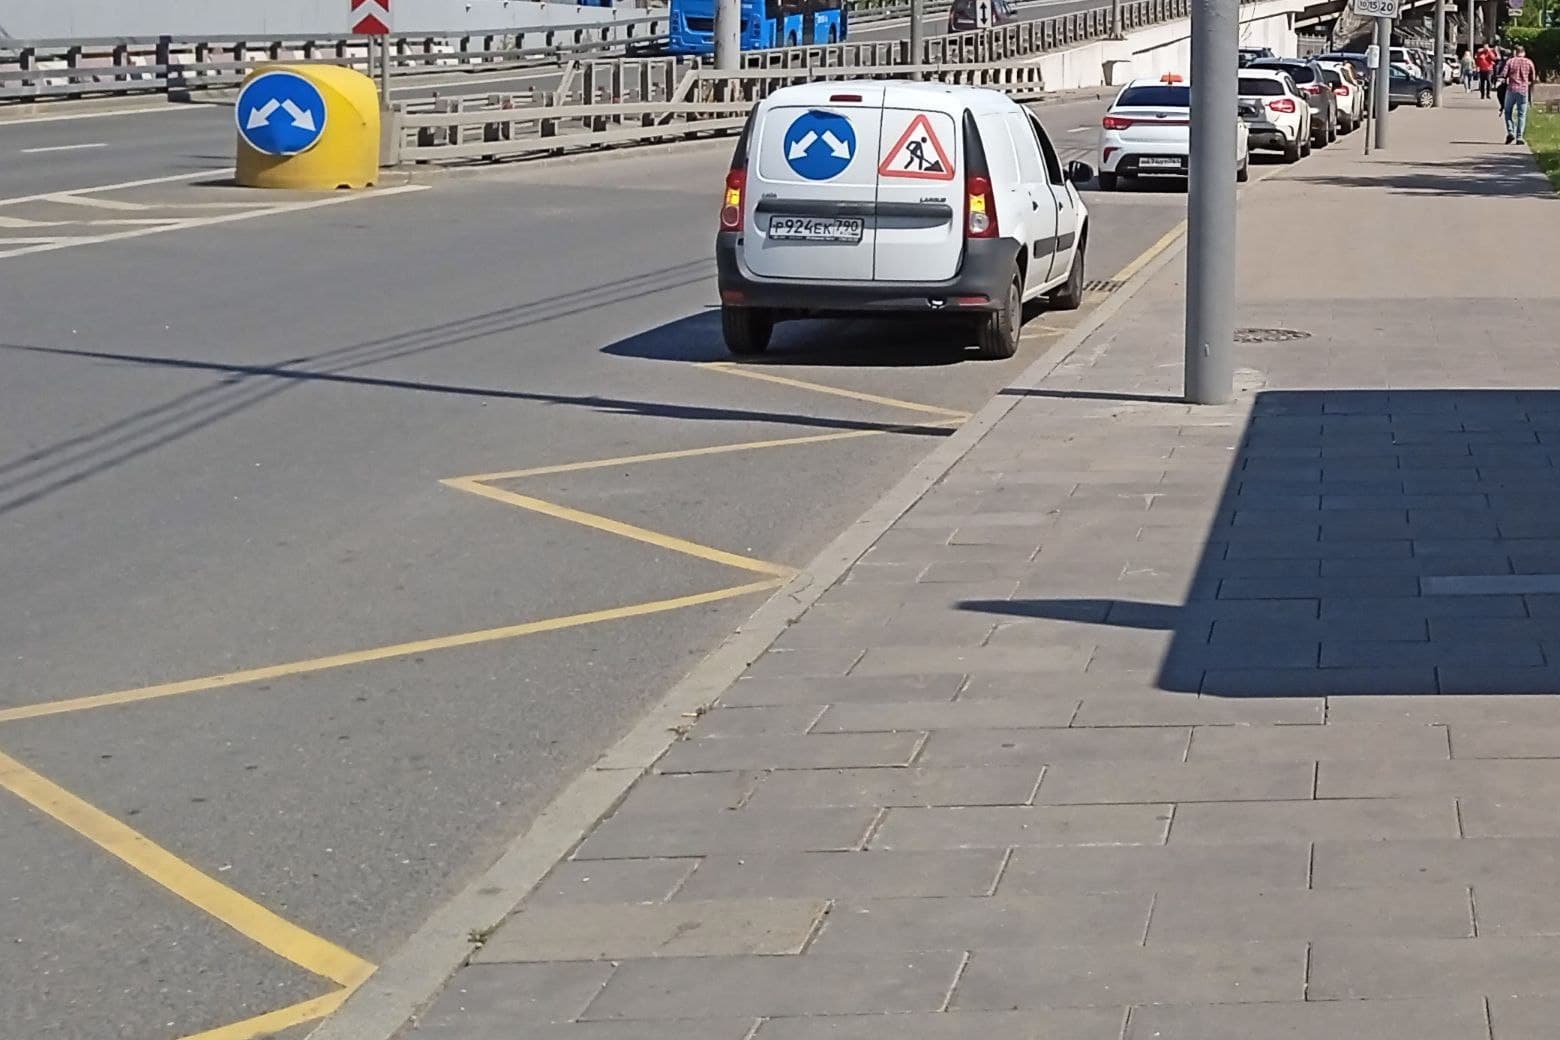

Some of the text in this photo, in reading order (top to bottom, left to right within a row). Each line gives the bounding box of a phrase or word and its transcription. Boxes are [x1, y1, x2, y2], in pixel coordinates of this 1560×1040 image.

[1368, 0, 1378, 9] 15
[1380, 2, 1394, 12] 20
[835, 219, 859, 232] 790
